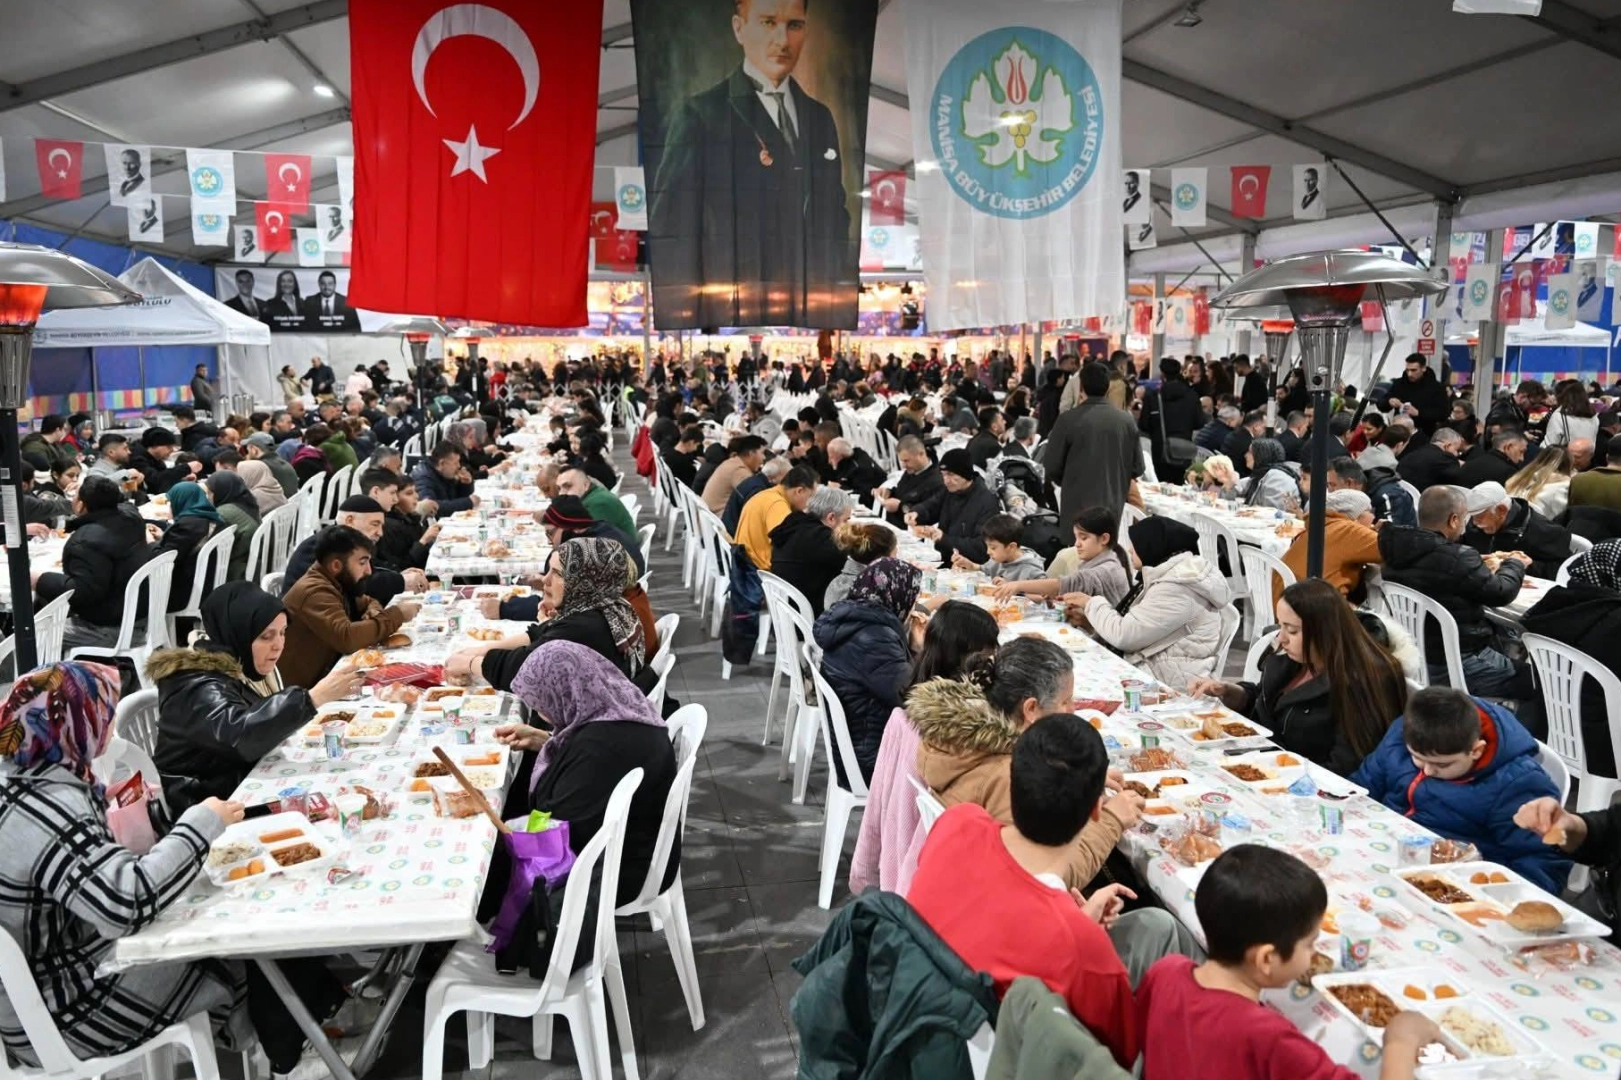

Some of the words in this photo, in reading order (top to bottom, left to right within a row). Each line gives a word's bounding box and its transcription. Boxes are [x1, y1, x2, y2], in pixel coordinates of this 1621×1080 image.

[938, 94, 958, 173] MANİSA
[955, 171, 1064, 216] BÜYÜKŞEHİR
[1062, 86, 1098, 191] BELEDİYESİ
